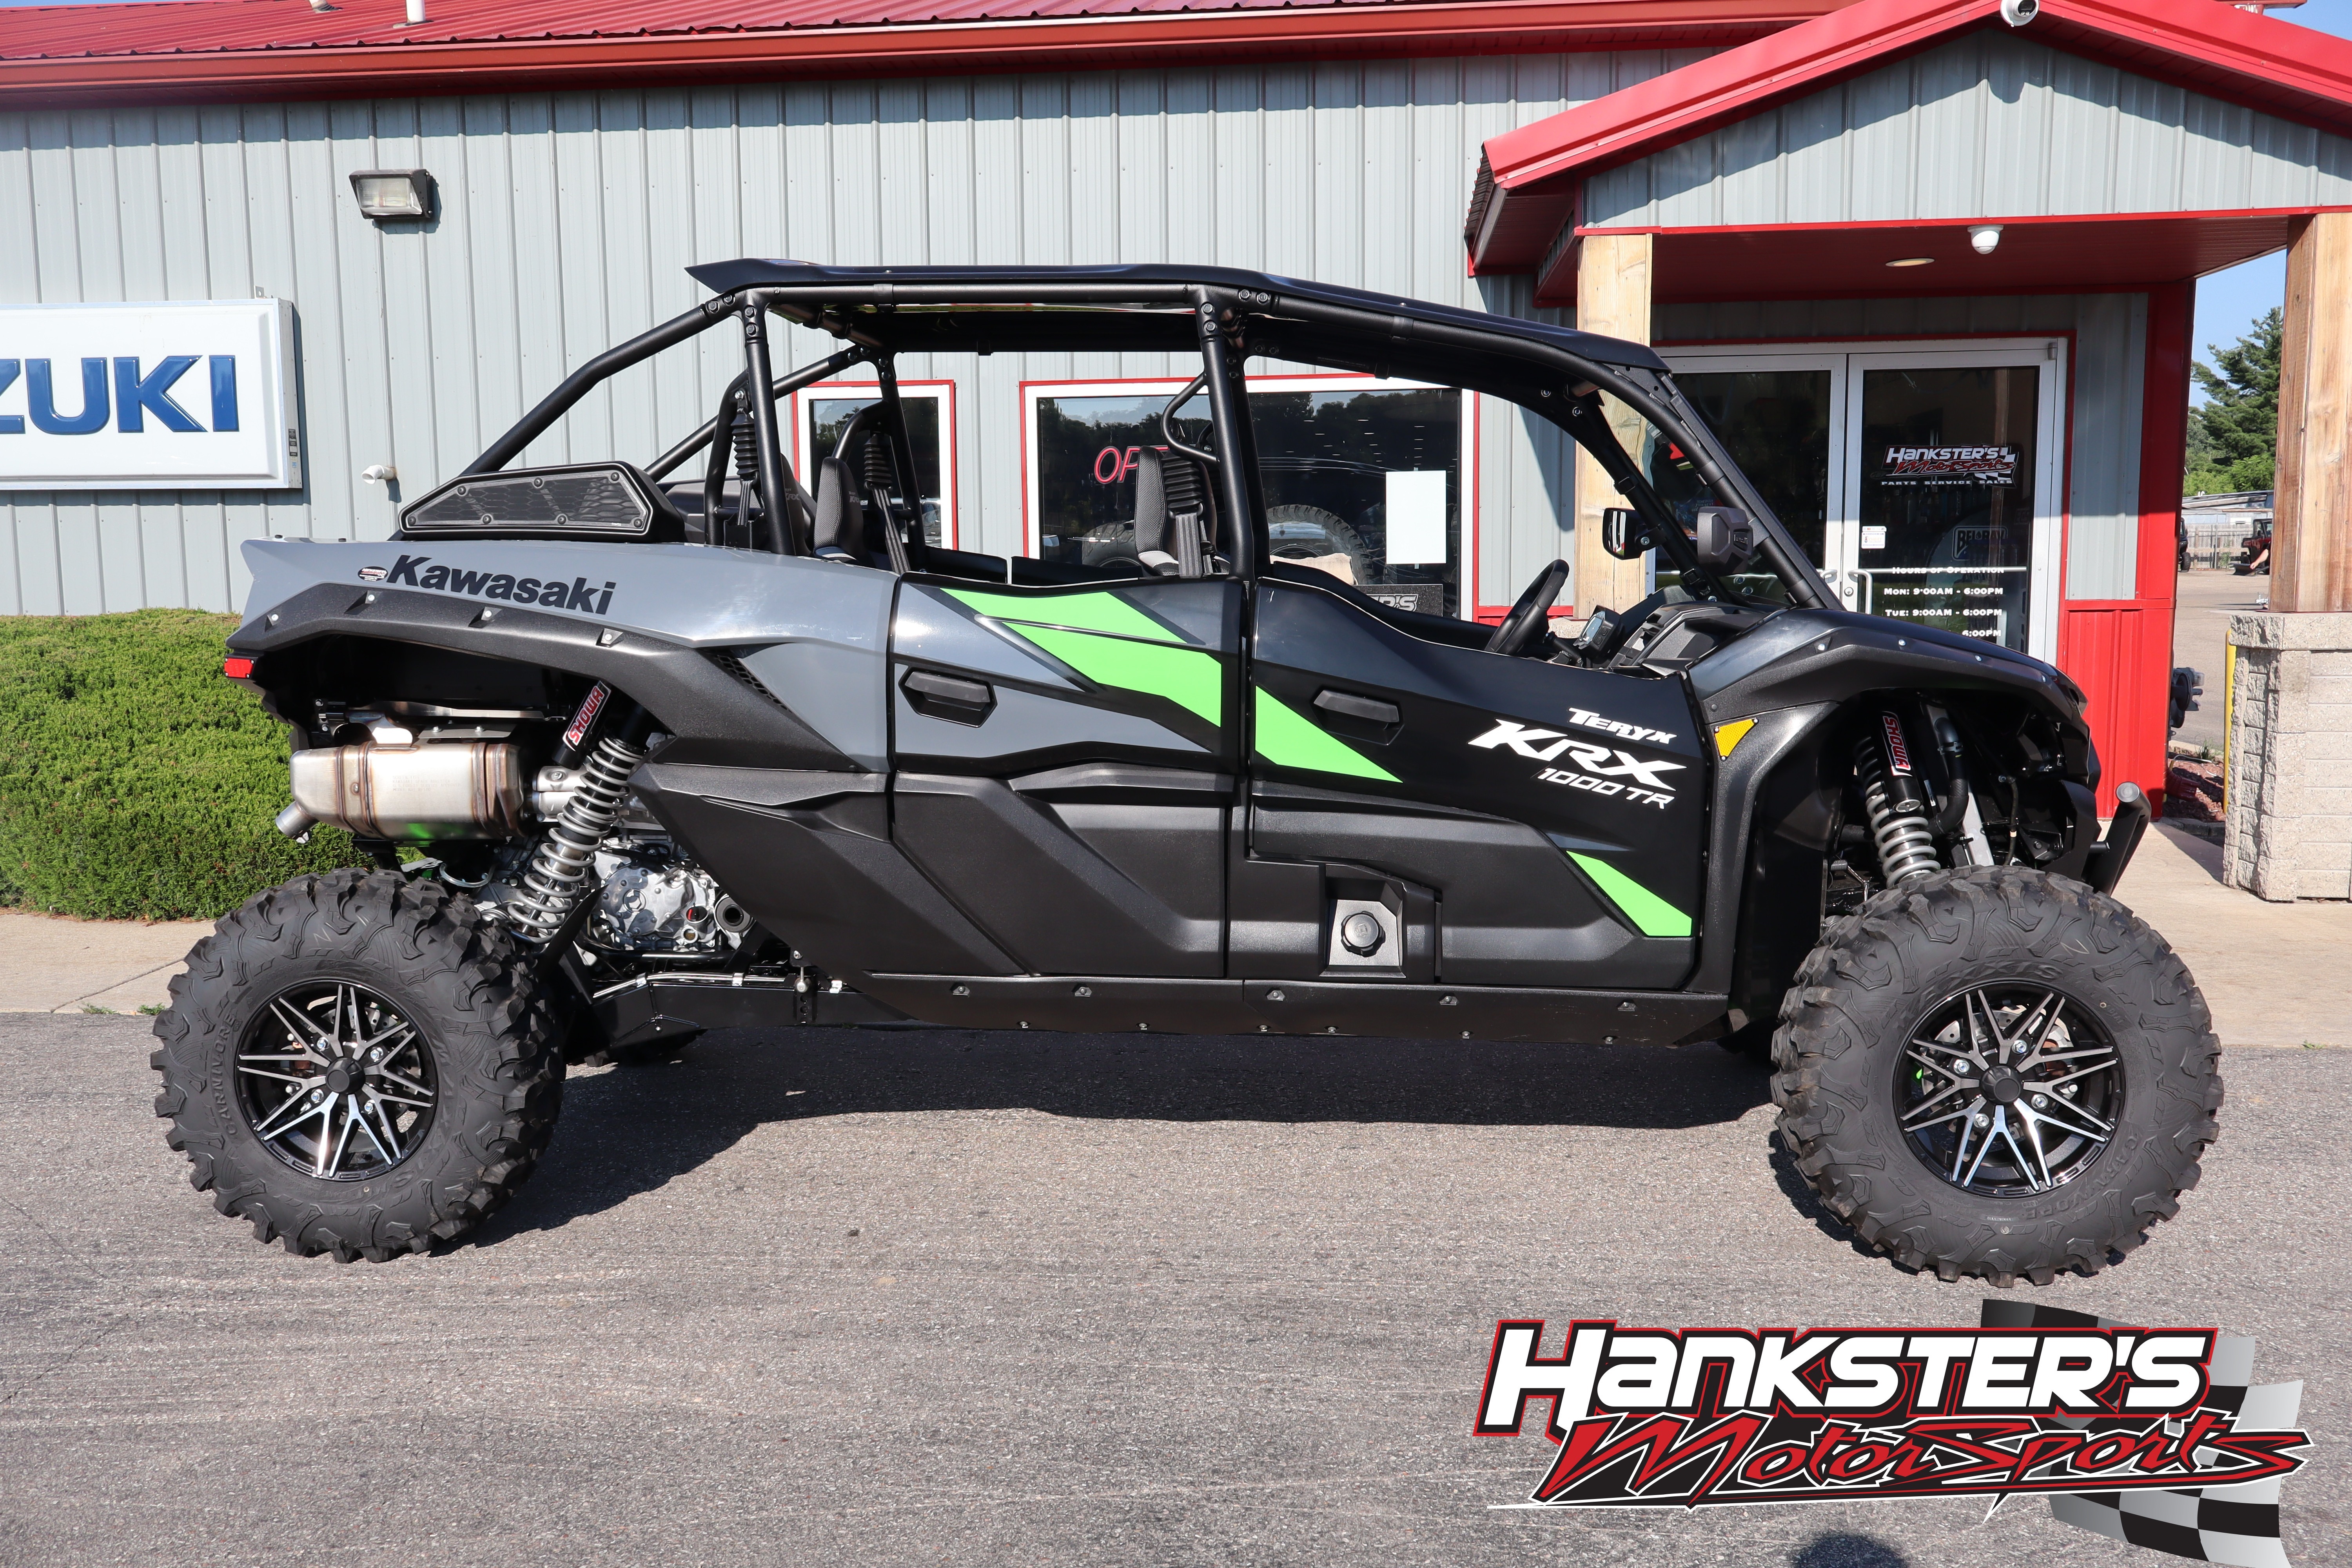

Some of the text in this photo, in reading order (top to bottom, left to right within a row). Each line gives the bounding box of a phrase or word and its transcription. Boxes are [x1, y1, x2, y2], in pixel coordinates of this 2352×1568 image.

[1094, 445, 1170, 485] OP
[1886, 447, 2000, 463] HANKSTER'S
[387, 555, 617, 615] Kawasaki
[568, 686, 604, 746] SHOWA
[1883, 716, 1911, 771] SHOWA
[1467, 718, 1687, 791] KRX
[1537, 768, 1675, 809] 1000 TR
[212, 1013, 237, 1135] CARNIVORE
